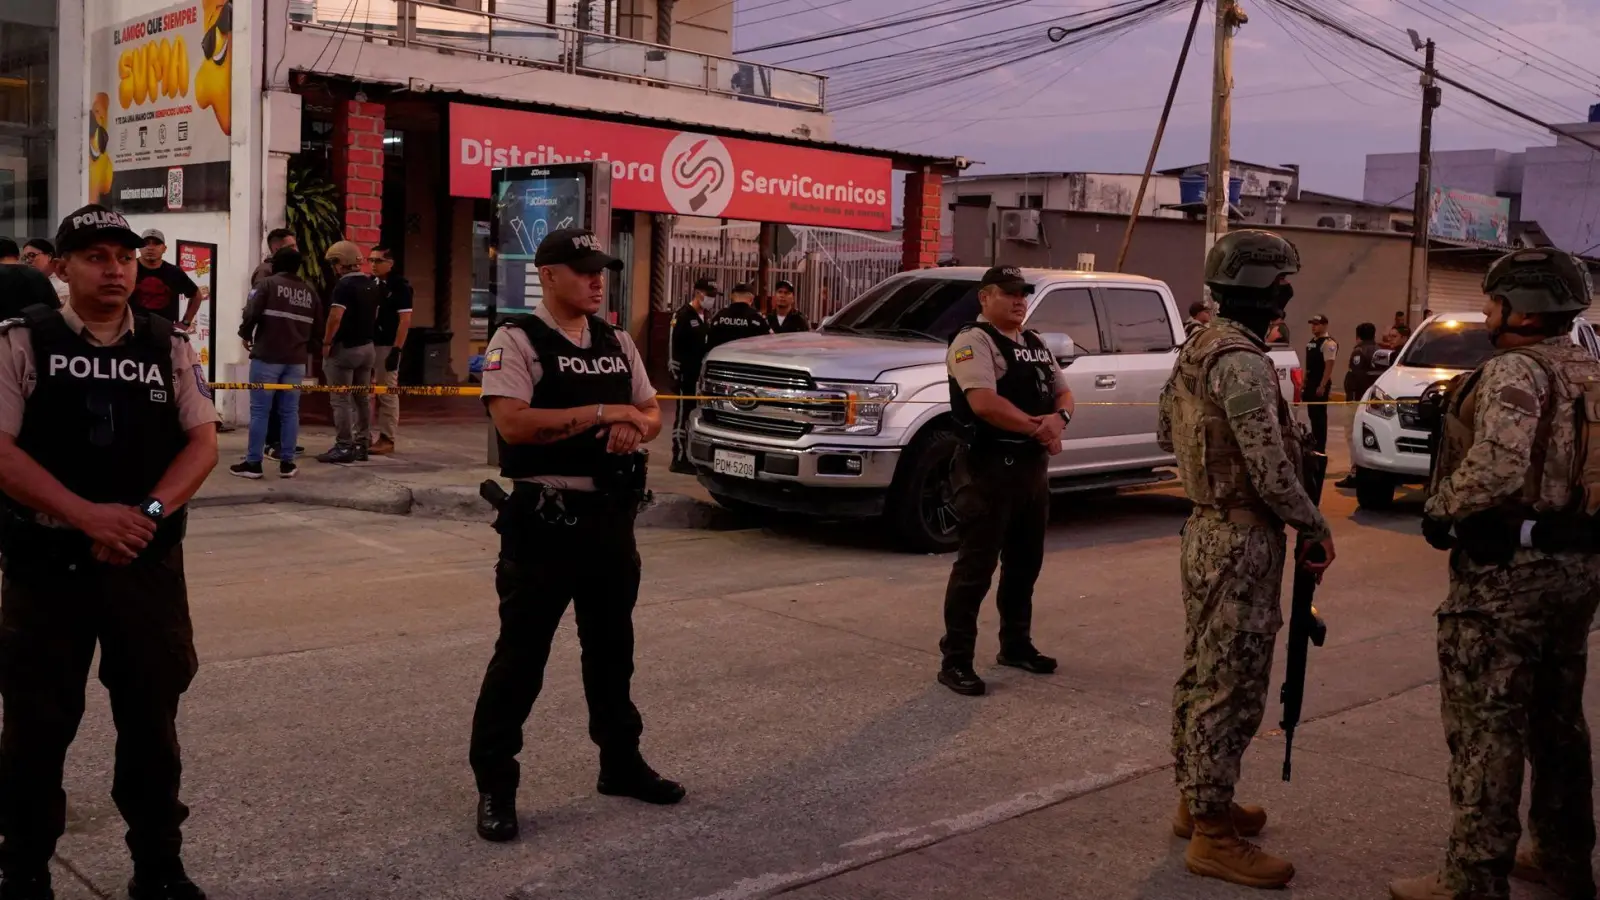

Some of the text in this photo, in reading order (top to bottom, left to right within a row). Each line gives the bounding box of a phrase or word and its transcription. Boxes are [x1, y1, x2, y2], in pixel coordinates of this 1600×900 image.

[114, 6, 197, 45] EL AMIGO QUE SIEMPRE
[118, 35, 189, 109] SUMA
[741, 169, 886, 205] ServiCarnicos
[719, 317, 748, 326] POLICIA
[558, 355, 628, 375] POLICIA
[1013, 348, 1052, 364] POLICIA
[50, 354, 164, 386] POLICIA
[715, 458, 753, 475] PDM-5209
